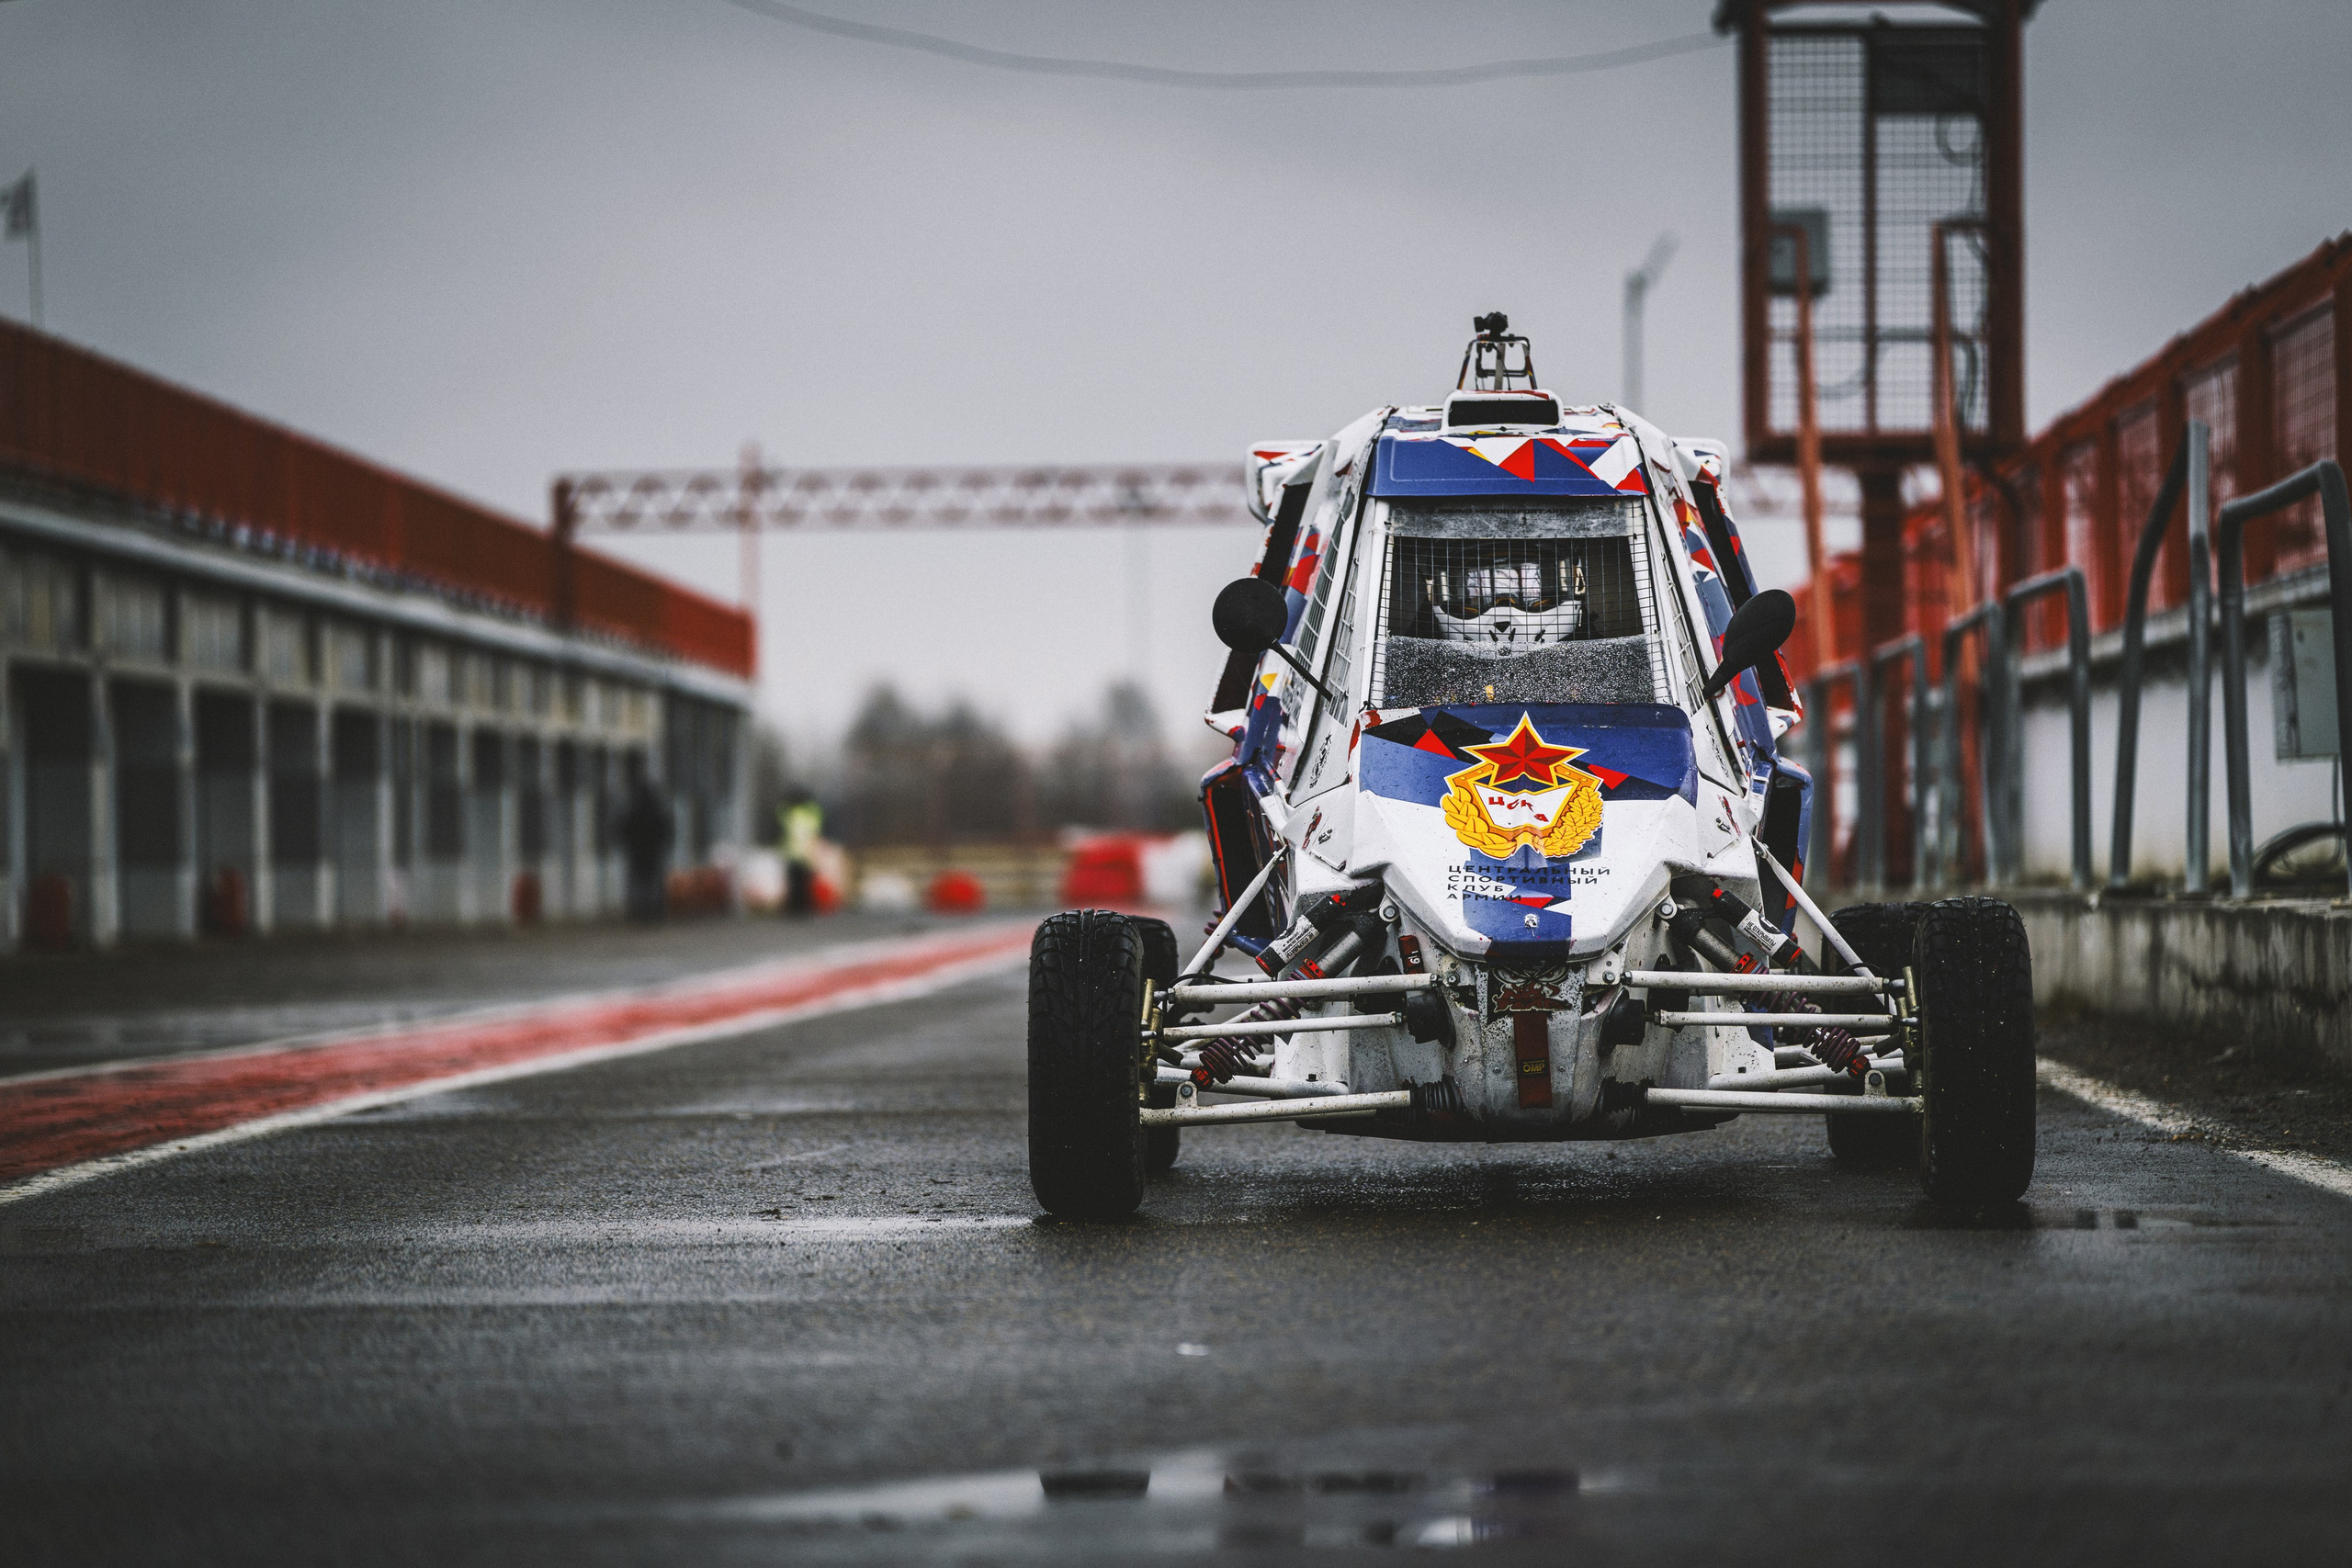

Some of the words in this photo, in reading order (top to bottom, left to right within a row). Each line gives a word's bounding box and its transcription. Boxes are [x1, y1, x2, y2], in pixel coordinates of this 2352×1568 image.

[1488, 795, 1550, 822] ЦСКА
[1448, 864, 1611, 875] ЦЕНТРАЛЬНЫЙ
[1448, 874, 1598, 885] СПОРТИВНЫЙ
[1447, 884, 1504, 893] КЛУБ
[1447, 893, 1521, 901] АРМИИ
[1522, 1062, 1545, 1073] OMP
